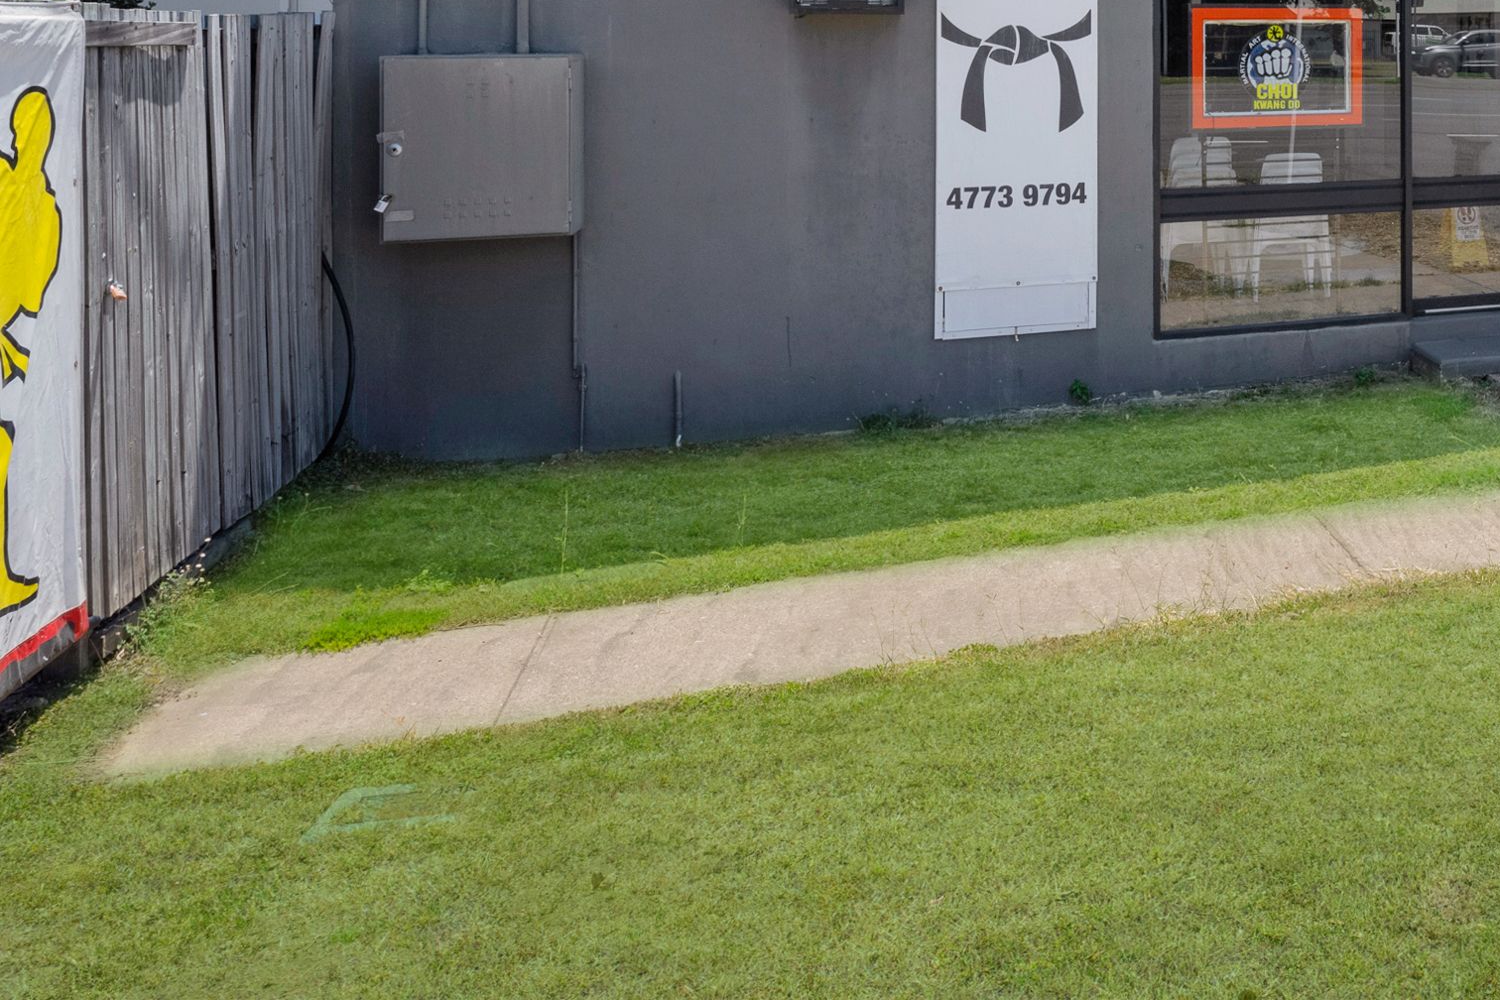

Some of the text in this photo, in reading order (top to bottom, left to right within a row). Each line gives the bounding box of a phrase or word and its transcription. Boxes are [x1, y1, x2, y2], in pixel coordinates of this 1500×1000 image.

[1240, 52, 1249, 84] MARTIAL
[1248, 36, 1261, 49] ART
[1256, 83, 1298, 99] CHOI
[1253, 100, 1301, 110] KWANG DO
[945, 182, 1088, 210] 4773 9794
